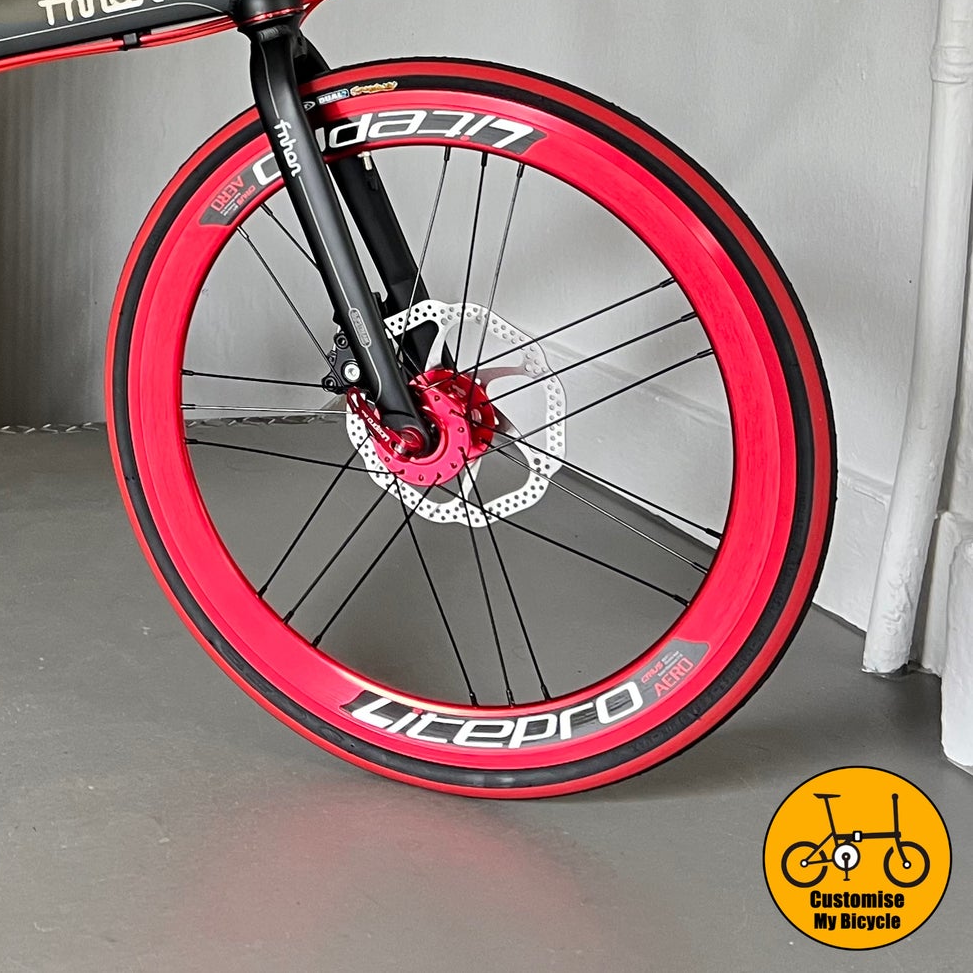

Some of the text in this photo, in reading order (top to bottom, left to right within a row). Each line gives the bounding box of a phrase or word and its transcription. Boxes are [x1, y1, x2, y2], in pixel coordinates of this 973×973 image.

[273, 119, 302, 178] fnhon
[654, 657, 694, 697] AERO
[351, 681, 643, 748] Litepro
